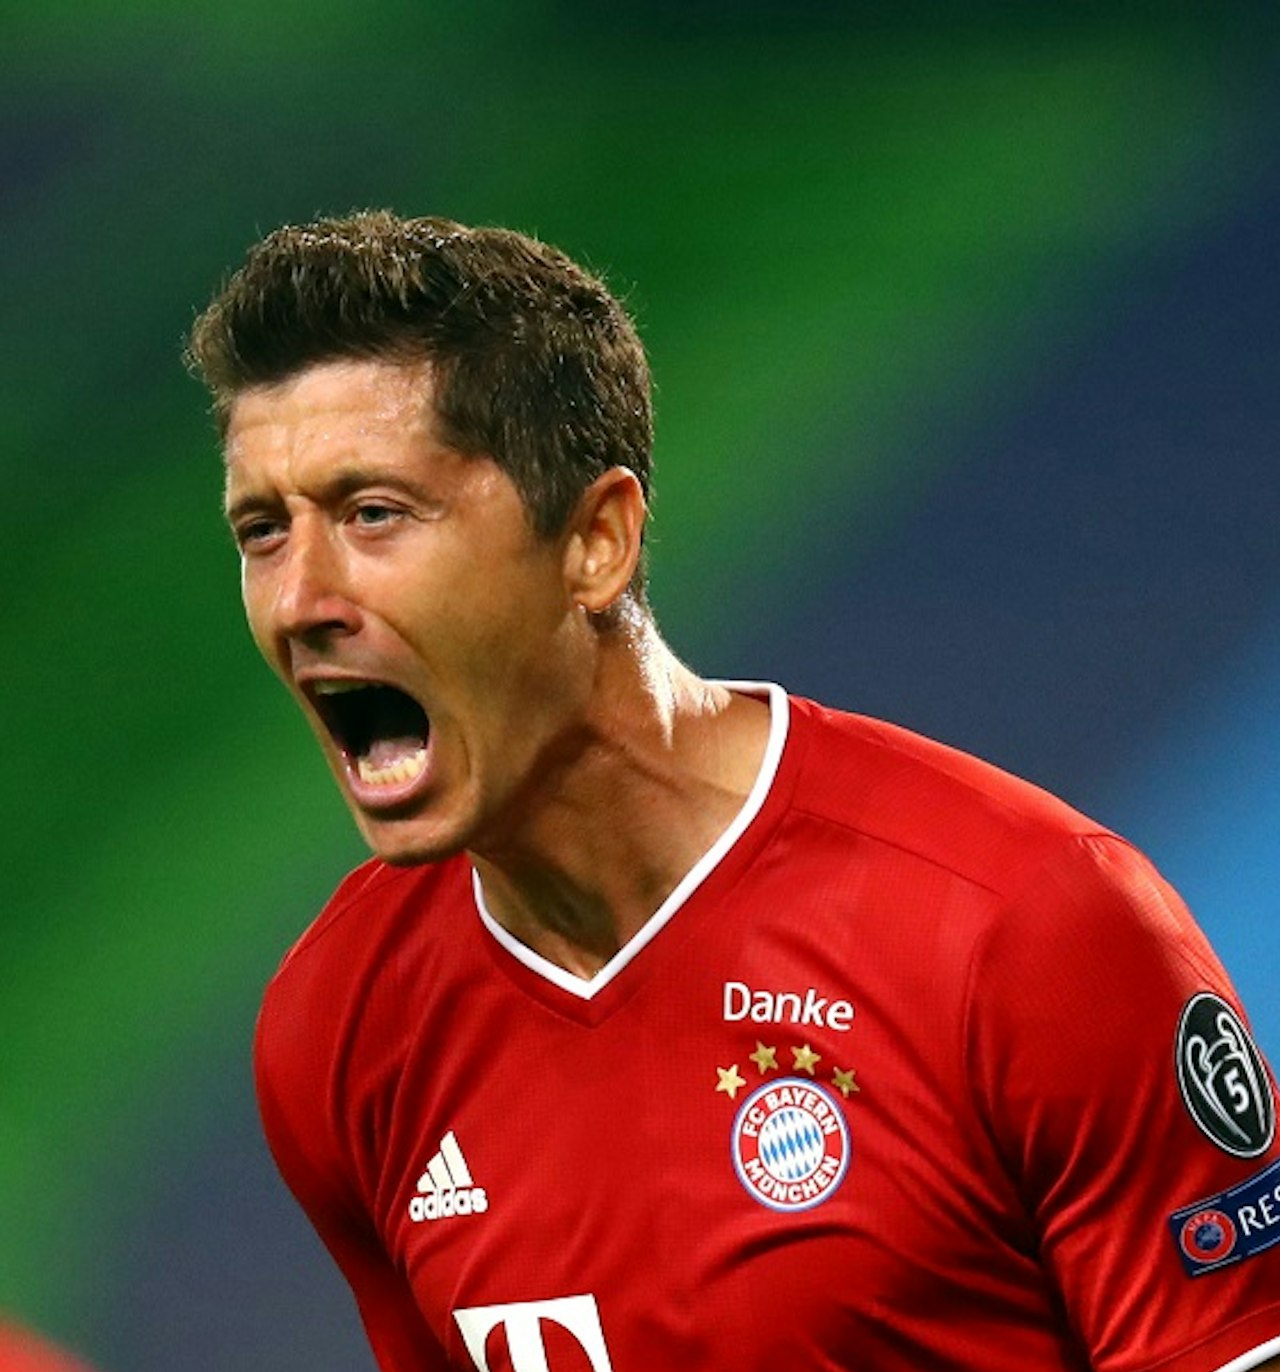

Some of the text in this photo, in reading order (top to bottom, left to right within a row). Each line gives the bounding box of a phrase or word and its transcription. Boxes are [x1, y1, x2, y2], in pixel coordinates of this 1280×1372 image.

[723, 981, 855, 1031] Danke
[742, 1087, 838, 1138] FC BAYERN
[1224, 1068, 1249, 1114] 5
[409, 1187, 489, 1222] adidas
